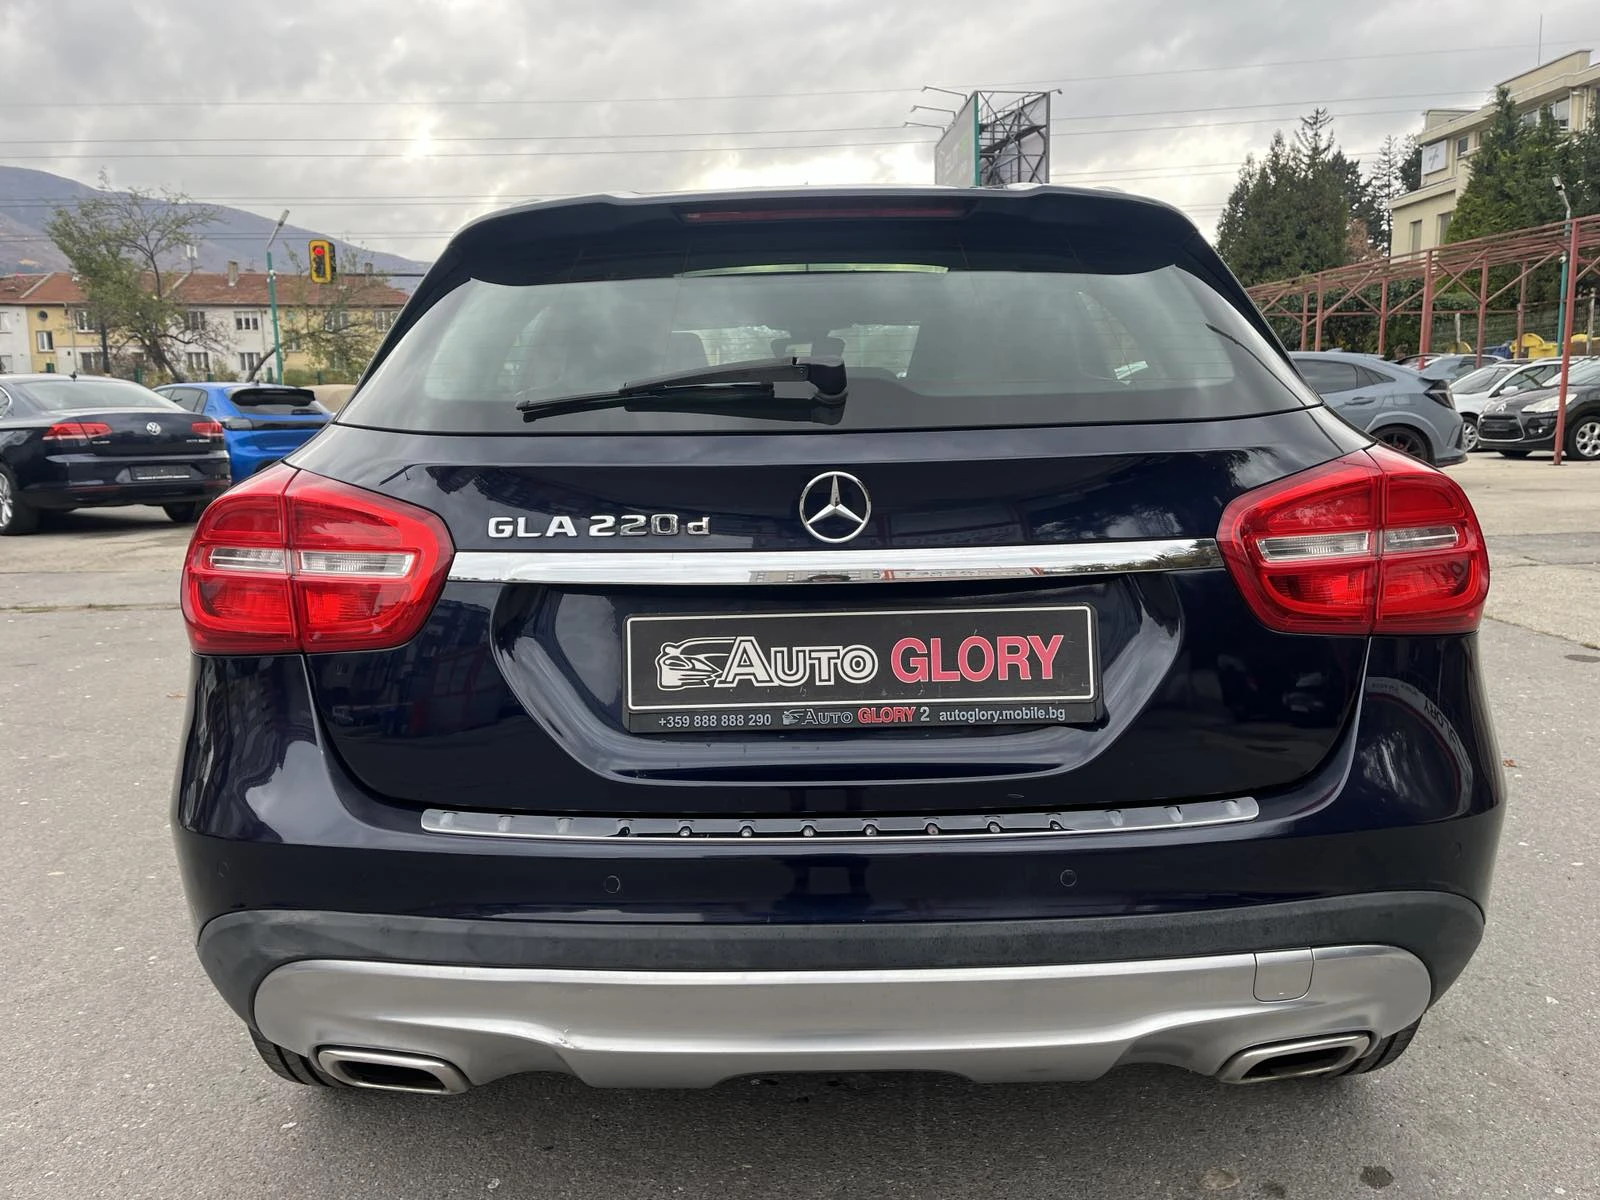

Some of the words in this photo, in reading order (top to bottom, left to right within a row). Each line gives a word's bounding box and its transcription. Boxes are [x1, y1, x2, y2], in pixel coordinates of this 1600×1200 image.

[488, 516, 577, 537] GLA
[891, 634, 1063, 683] GLORY
[658, 715, 690, 727] +359
[693, 714, 717, 726] 888
[721, 714, 744, 726] 888
[748, 713, 772, 725] 290
[857, 706, 916, 723] GLORY
[920, 706, 930, 721] 2
[939, 707, 1065, 723] autoglory.mobile.bg
